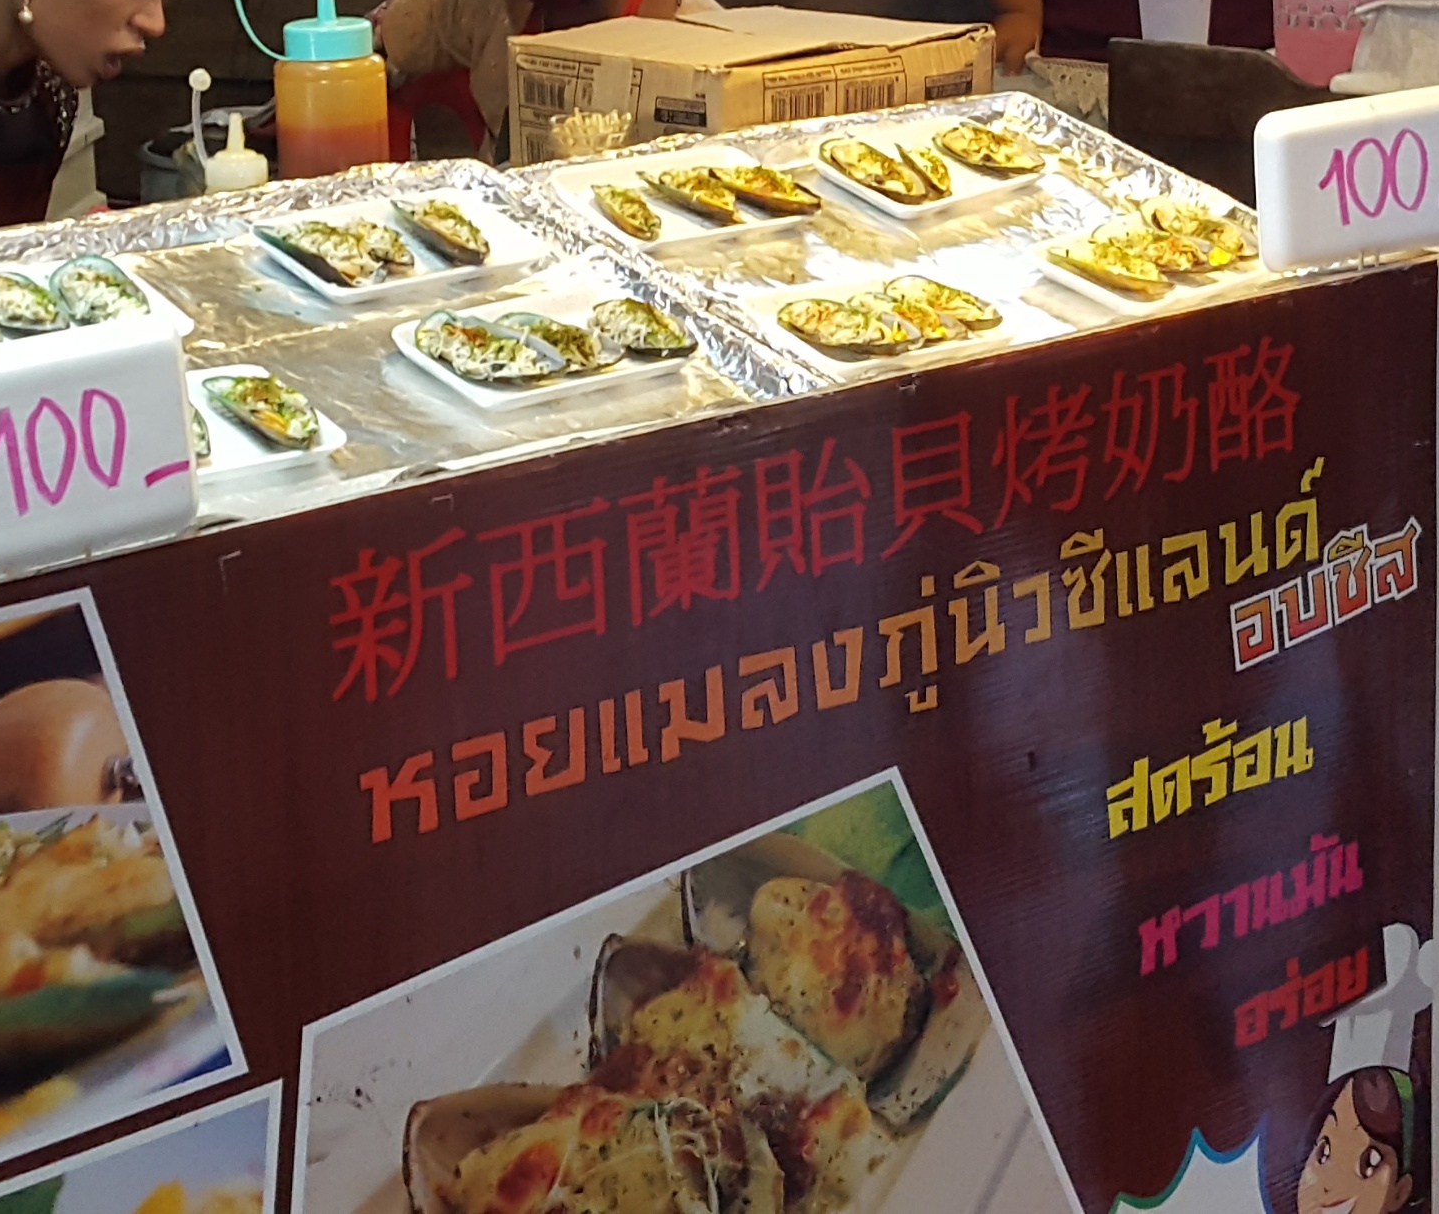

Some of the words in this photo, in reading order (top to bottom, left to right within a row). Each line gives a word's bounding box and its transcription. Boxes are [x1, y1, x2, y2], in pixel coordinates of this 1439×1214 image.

[329, 335, 1301, 703] 新西蘭貽貝烤奶酪
[1230, 516, 1422, 672] อบชีส
[1107, 716, 1313, 839] สดร้อน
[1138, 834, 1363, 976] หวานมัน
[1234, 946, 1368, 1047] อร่อย
